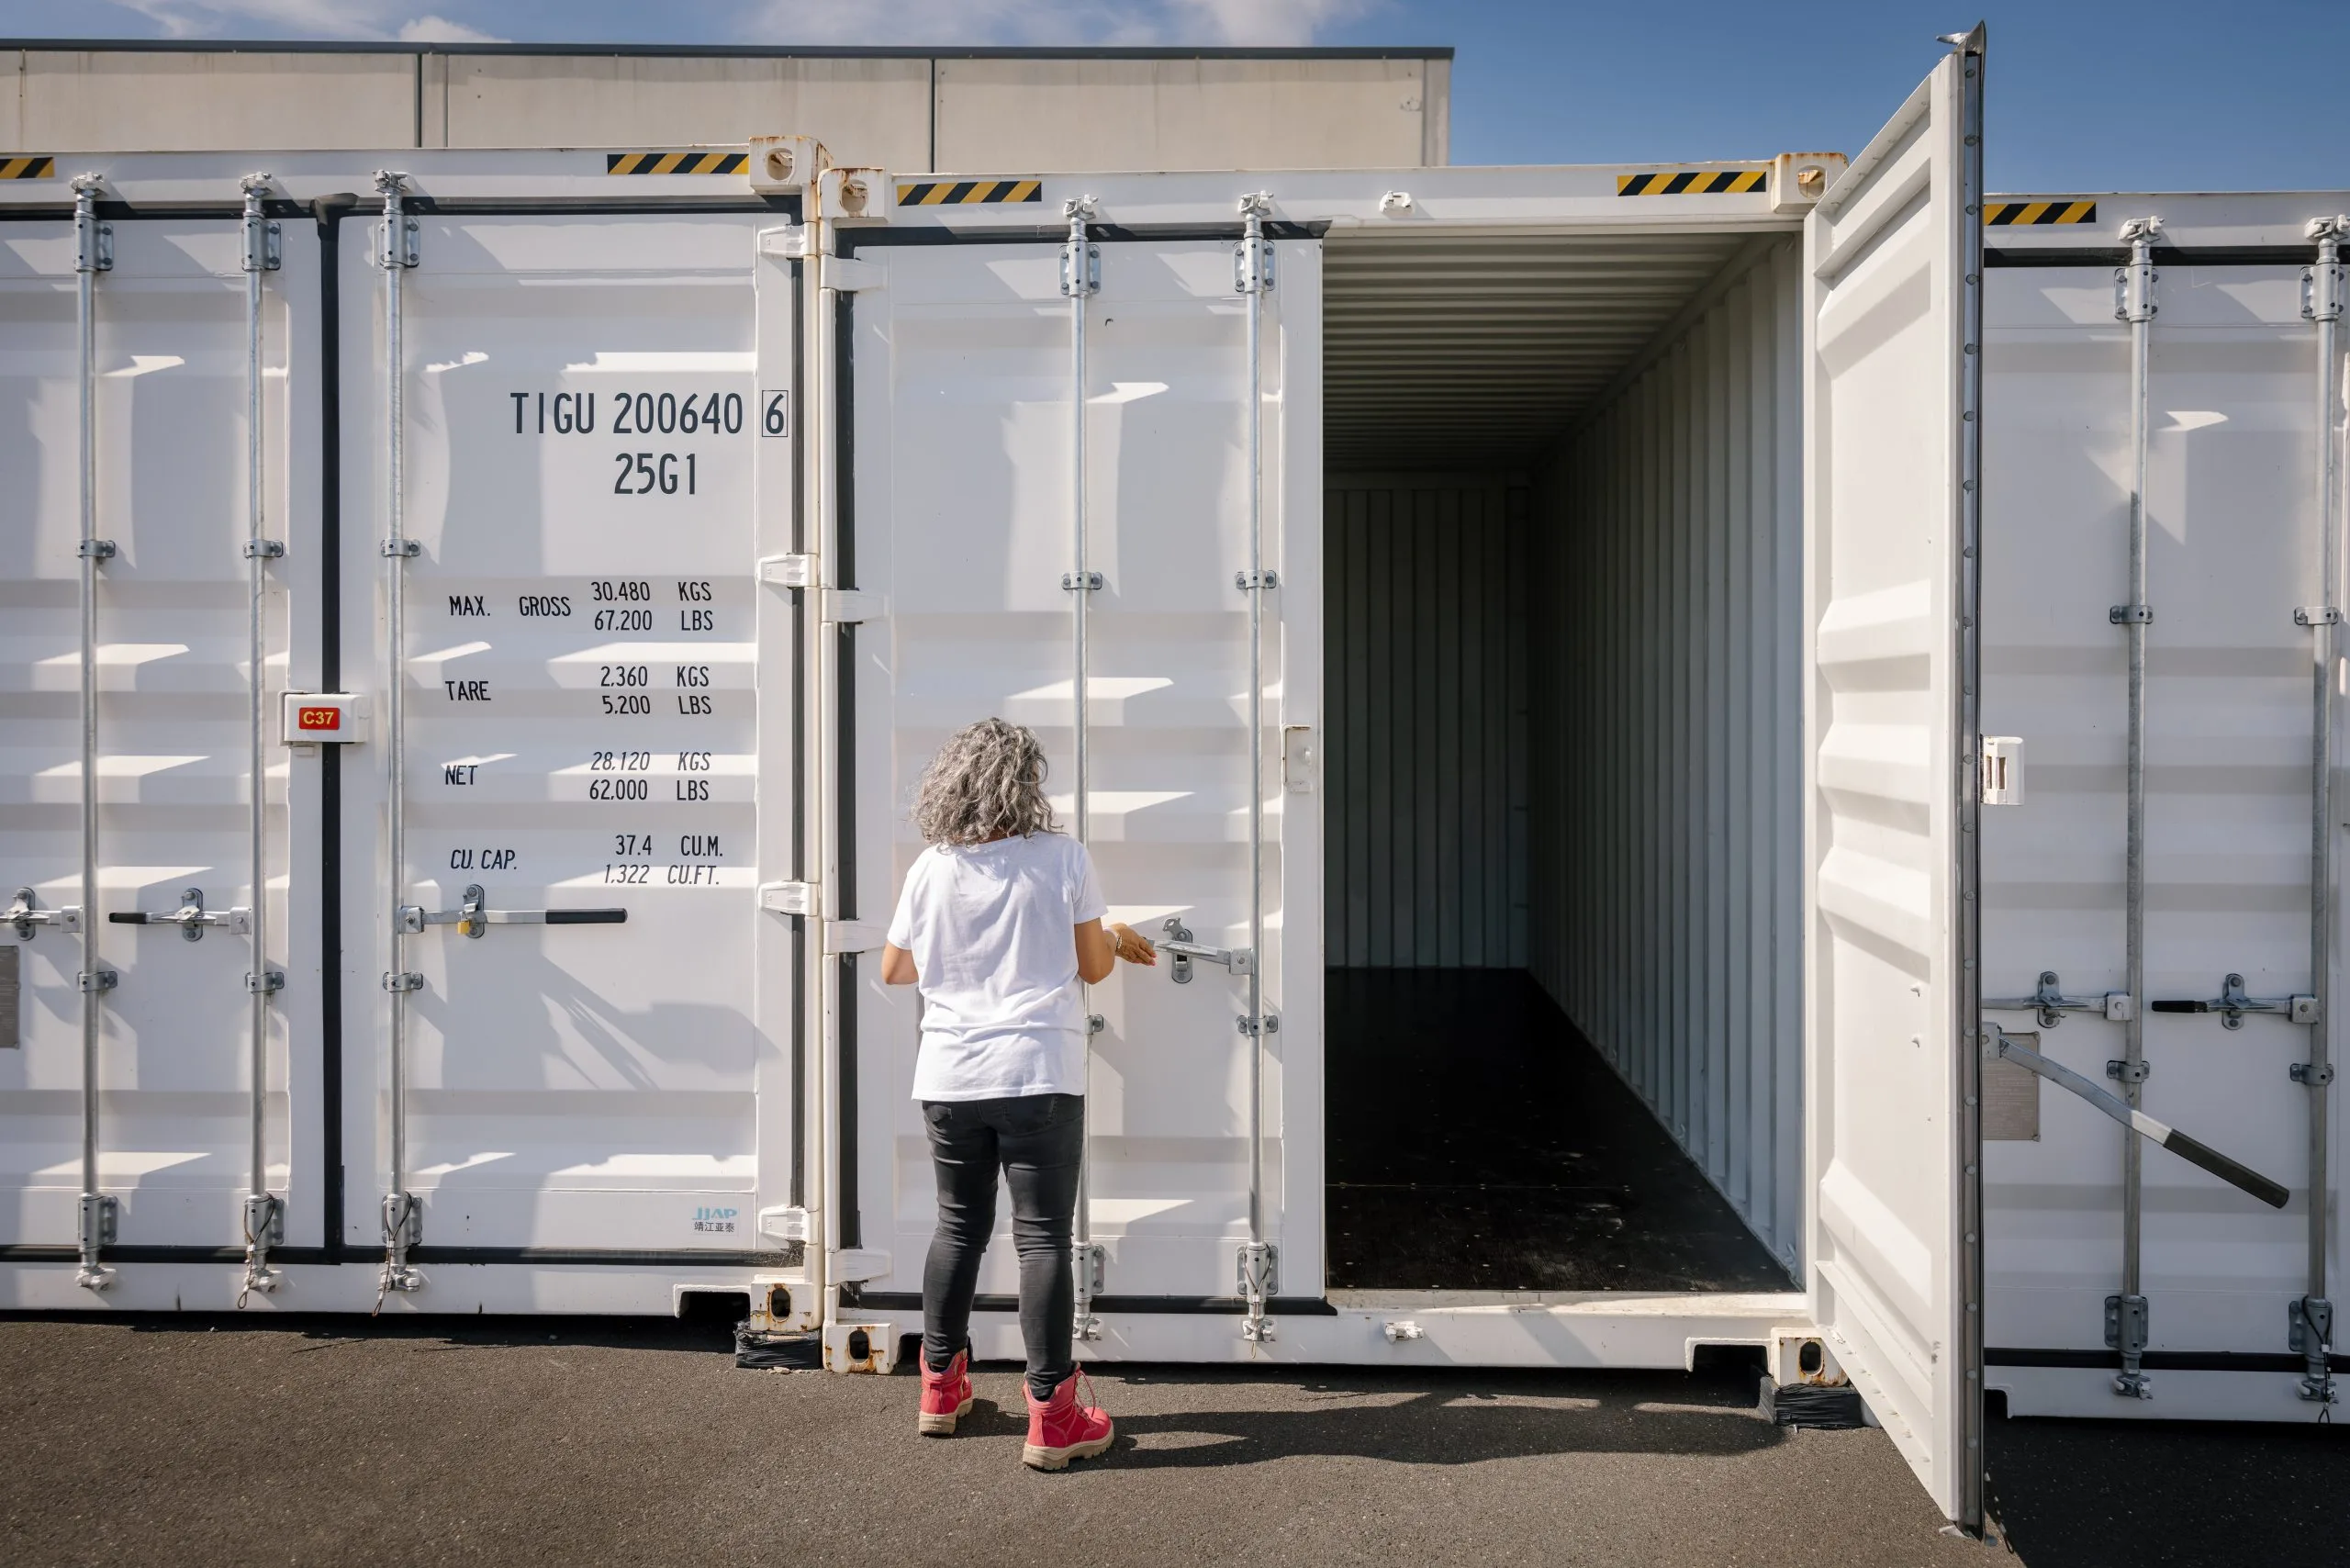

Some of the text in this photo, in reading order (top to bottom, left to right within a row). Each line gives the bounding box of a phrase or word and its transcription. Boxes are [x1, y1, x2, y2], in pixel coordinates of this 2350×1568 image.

[510, 392, 784, 435] TIGU 200640 6
[614, 453, 696, 496] 25G1
[677, 581, 712, 602] KGS
[448, 595, 572, 617] MAX. GROSS
[680, 610, 713, 632] LBS
[677, 666, 710, 688] KGS
[444, 680, 492, 701] TARE
[677, 695, 712, 715] LBS
[303, 711, 334, 725] C37
[677, 751, 711, 771] KGS
[444, 765, 479, 786] NET
[676, 779, 710, 801] LBS
[615, 834, 723, 857] 37.4 CU.M.
[450, 848, 518, 870] CU. CAP.
[666, 864, 720, 886] CU.FT.
[694, 1221, 734, 1233] 靖江亚泰
